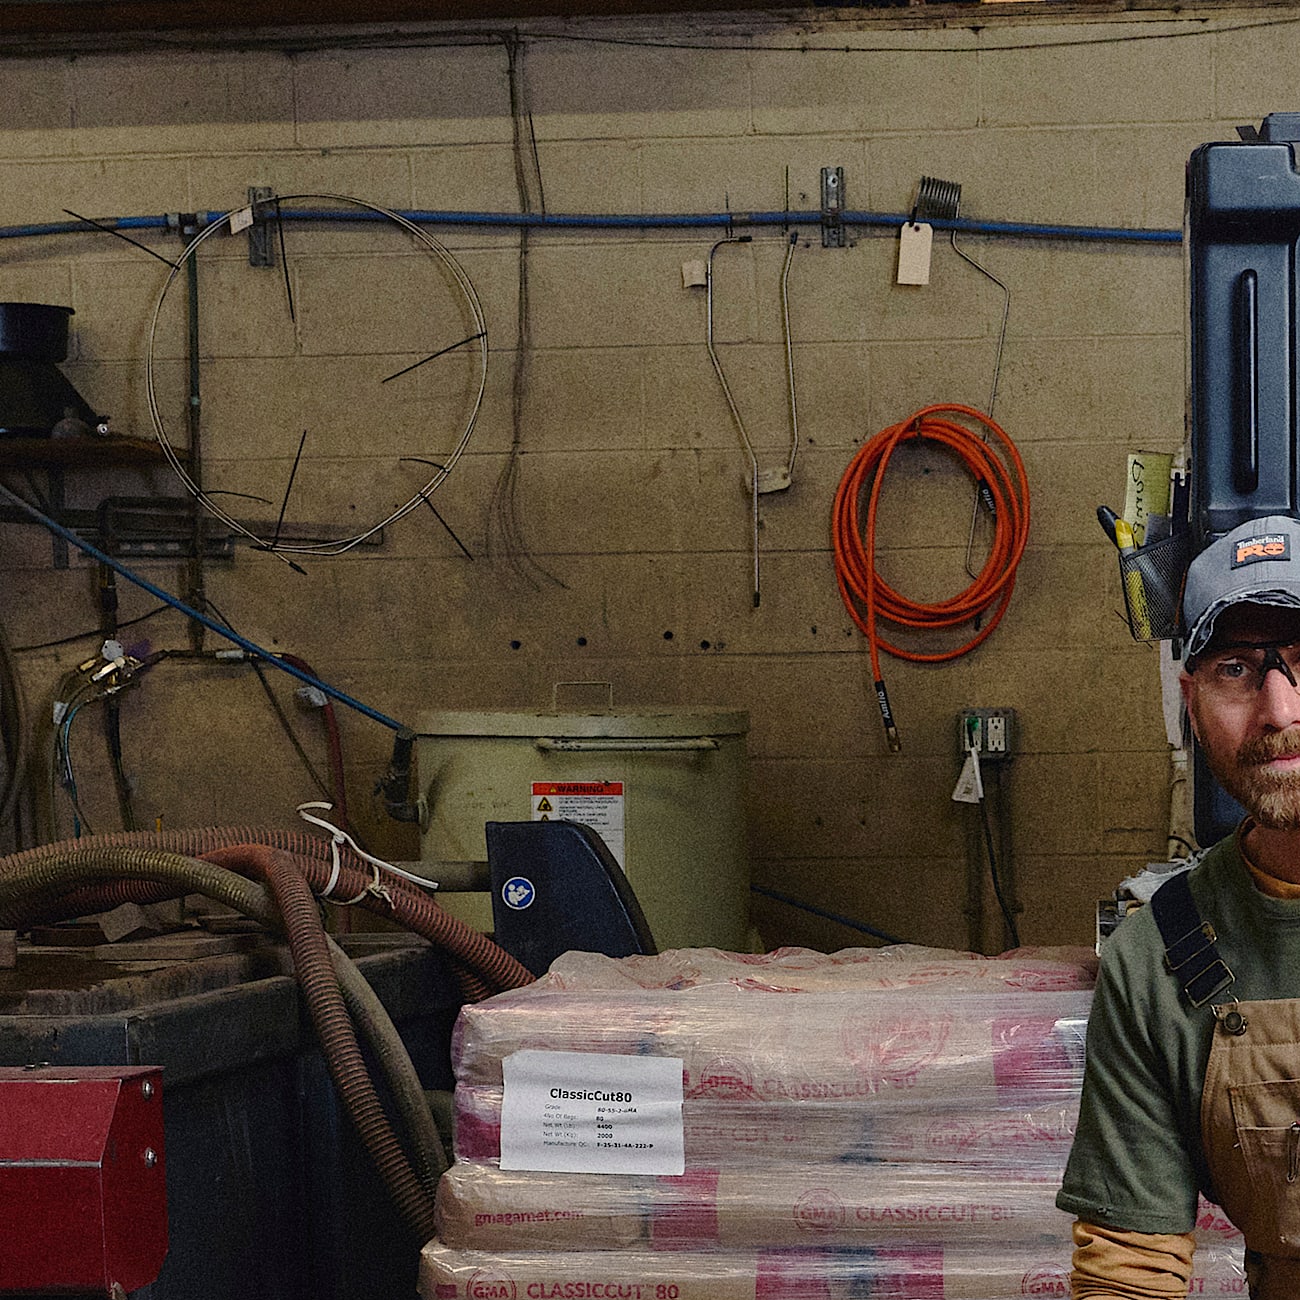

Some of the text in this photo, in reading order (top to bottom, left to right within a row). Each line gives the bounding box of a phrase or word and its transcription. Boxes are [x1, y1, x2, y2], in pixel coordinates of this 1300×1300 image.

[1237, 536, 1285, 549] Timberland
[557, 785, 604, 793] WARNING
[550, 1088, 632, 1103] ClassicCut80
[474, 1209, 584, 1227] gmagarnet.com
[473, 1284, 509, 1299] GMA
[656, 1284, 680, 1300] 80
[1029, 1283, 1066, 1296] GMA
